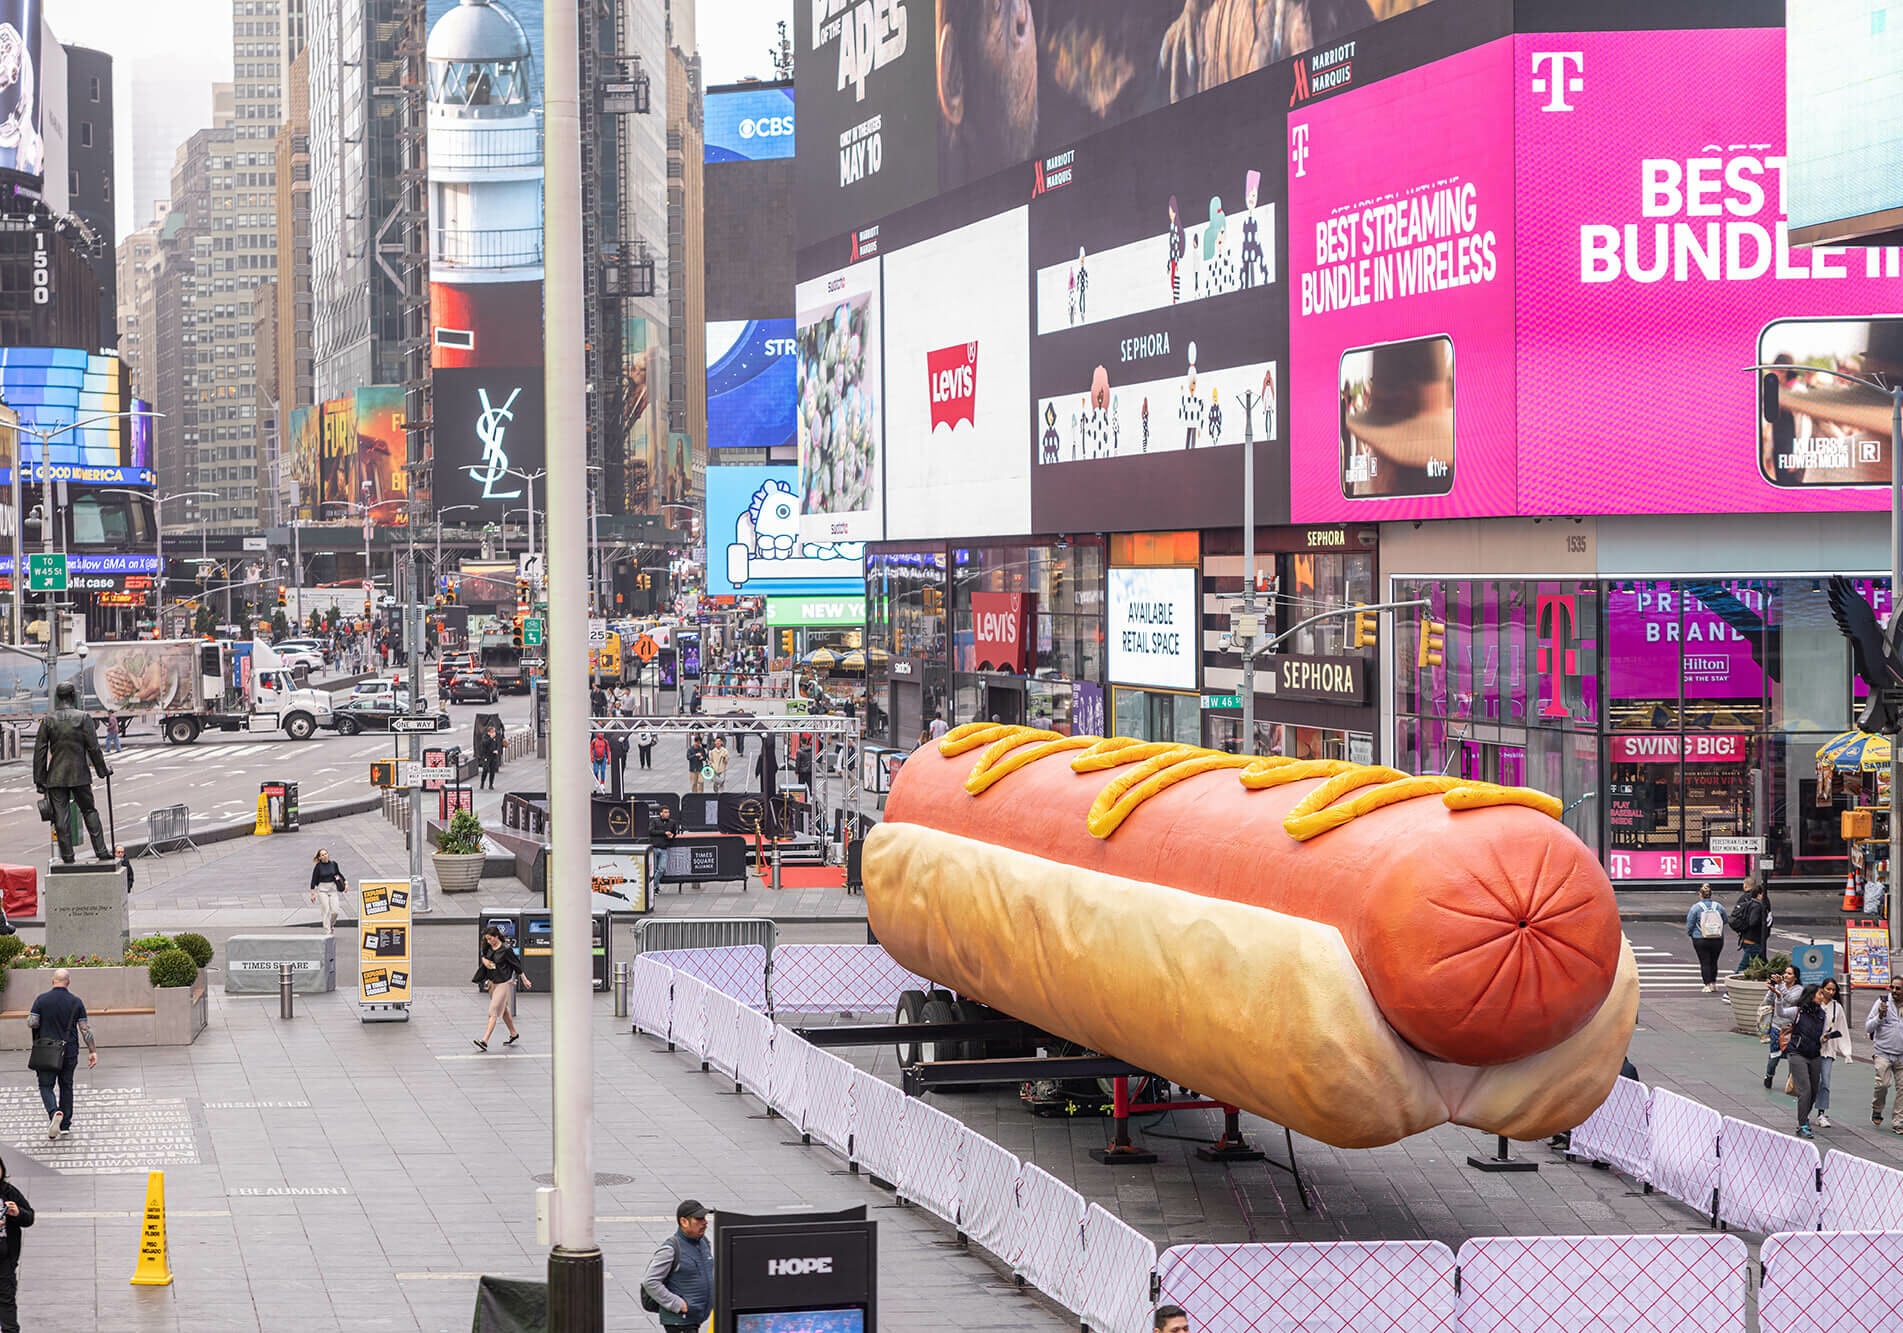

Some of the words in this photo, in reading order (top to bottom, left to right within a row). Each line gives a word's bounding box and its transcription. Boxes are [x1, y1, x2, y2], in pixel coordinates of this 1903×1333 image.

[1312, 41, 1356, 71] MARRIOTT
[1312, 67, 1351, 93] MARQUIS
[756, 116, 795, 137] CBS
[839, 138, 866, 188] MAY
[866, 132, 882, 176] 10
[1046, 150, 1075, 171] MARRIOTT
[1046, 168, 1072, 188] MARQUIS
[1315, 211, 1360, 266] BEST
[1361, 181, 1477, 255] STREAMING
[33, 232, 49, 304] 1500
[1301, 259, 1371, 317] BUNDLE
[1374, 252, 1394, 303] IN
[1396, 230, 1497, 298] WIRELESS
[764, 338, 797, 356] STR
[1121, 331, 1170, 362] SEPHORA
[1778, 454, 1817, 469] FLOWER
[1818, 452, 1849, 469] MOON
[35, 466, 71, 480] GOOD
[1307, 531, 1345, 547] SEPHORA
[1566, 535, 1586, 552] 1535
[42, 557, 54, 566] TO
[103, 558, 126, 570] GMA
[34, 568, 42, 576] W
[42, 568, 53, 577] 45
[54, 567, 63, 576] St
[802, 602, 844, 619] NEW
[1128, 602, 1173, 624] AVAILABLE
[589, 631, 605, 640] 25
[1122, 631, 1149, 654] RETAIL
[1151, 632, 1180, 656] SPACE
[1683, 658, 1725, 670] Hilton
[1283, 661, 1354, 694] SEPHORA
[1210, 697, 1219, 707] W
[1221, 697, 1233, 707] 46
[416, 721, 432, 729] WAY
[1625, 738, 1692, 755] SWING
[1696, 737, 1735, 755] BIG!
[692, 858, 715, 866] SQUARE
[242, 961, 272, 970] TIMES
[50, 1160, 141, 1168] BROADWAY
[239, 1187, 348, 1195] BEAUMONT
[768, 1256, 833, 1276] HOPE
